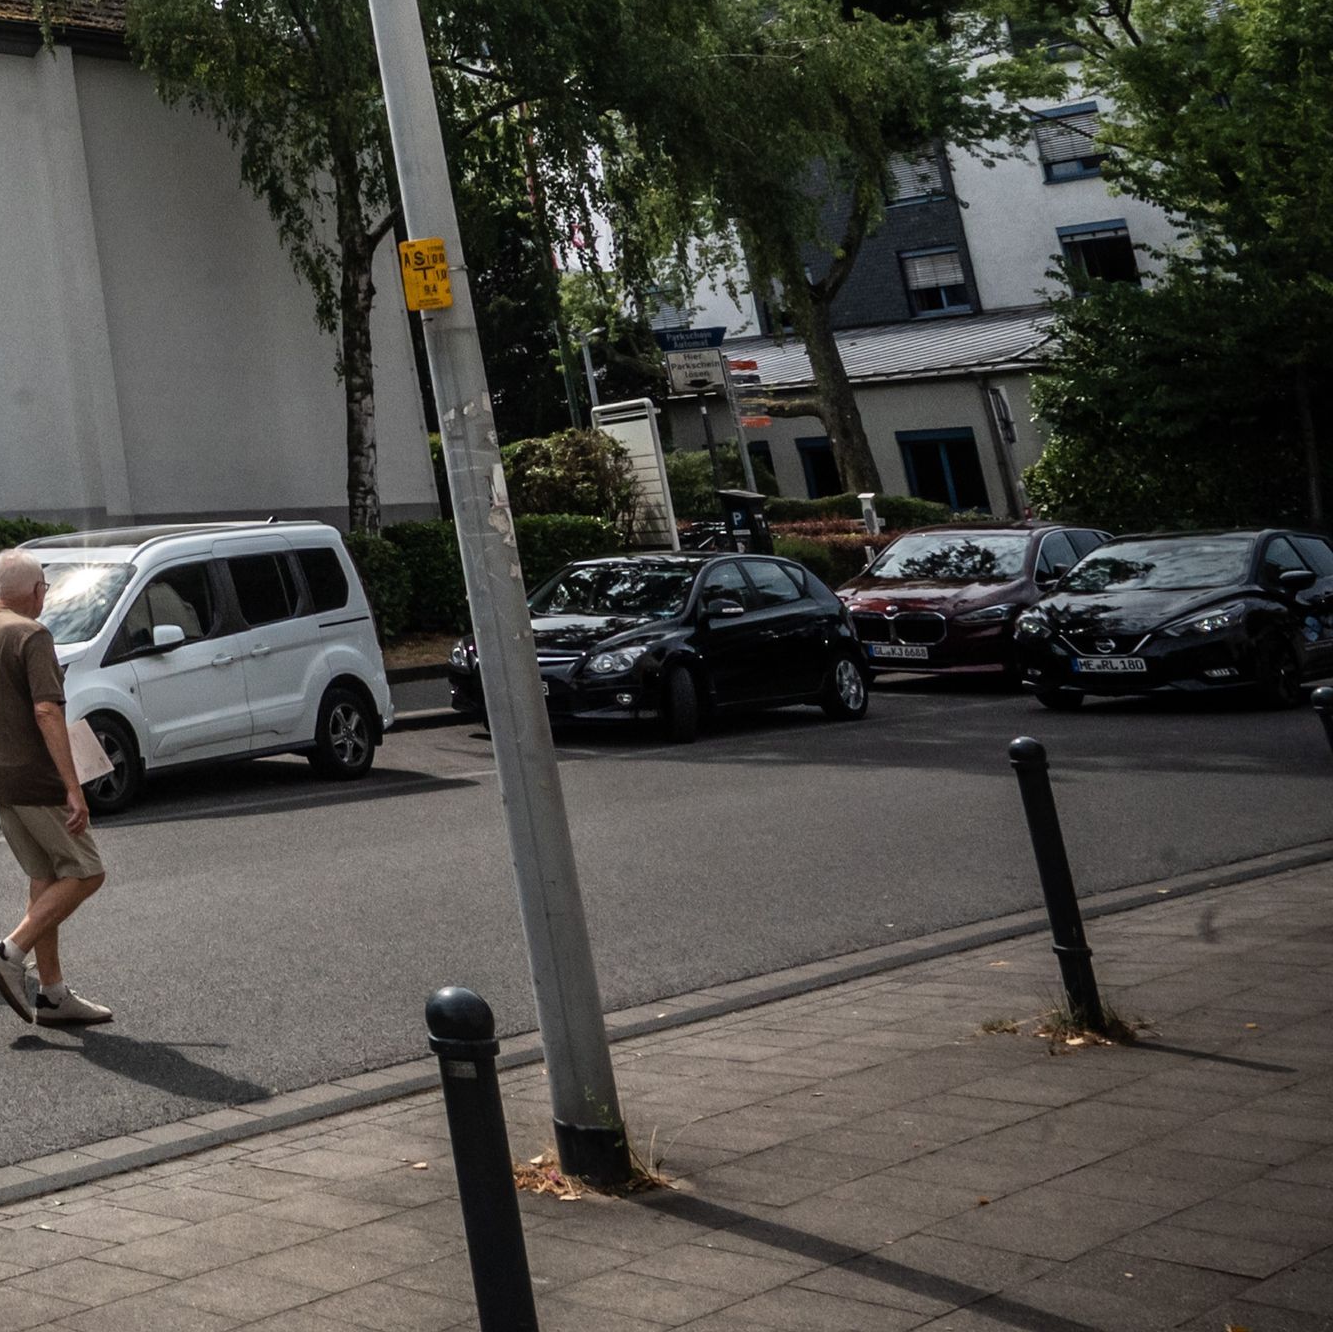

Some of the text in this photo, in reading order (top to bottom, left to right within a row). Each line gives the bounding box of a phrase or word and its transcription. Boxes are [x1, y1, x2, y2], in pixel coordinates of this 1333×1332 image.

[414, 251, 425, 266] S
[671, 361, 720, 370] Parkschein
[733, 511, 742, 526] P
[1119, 659, 1144, 670] 180
